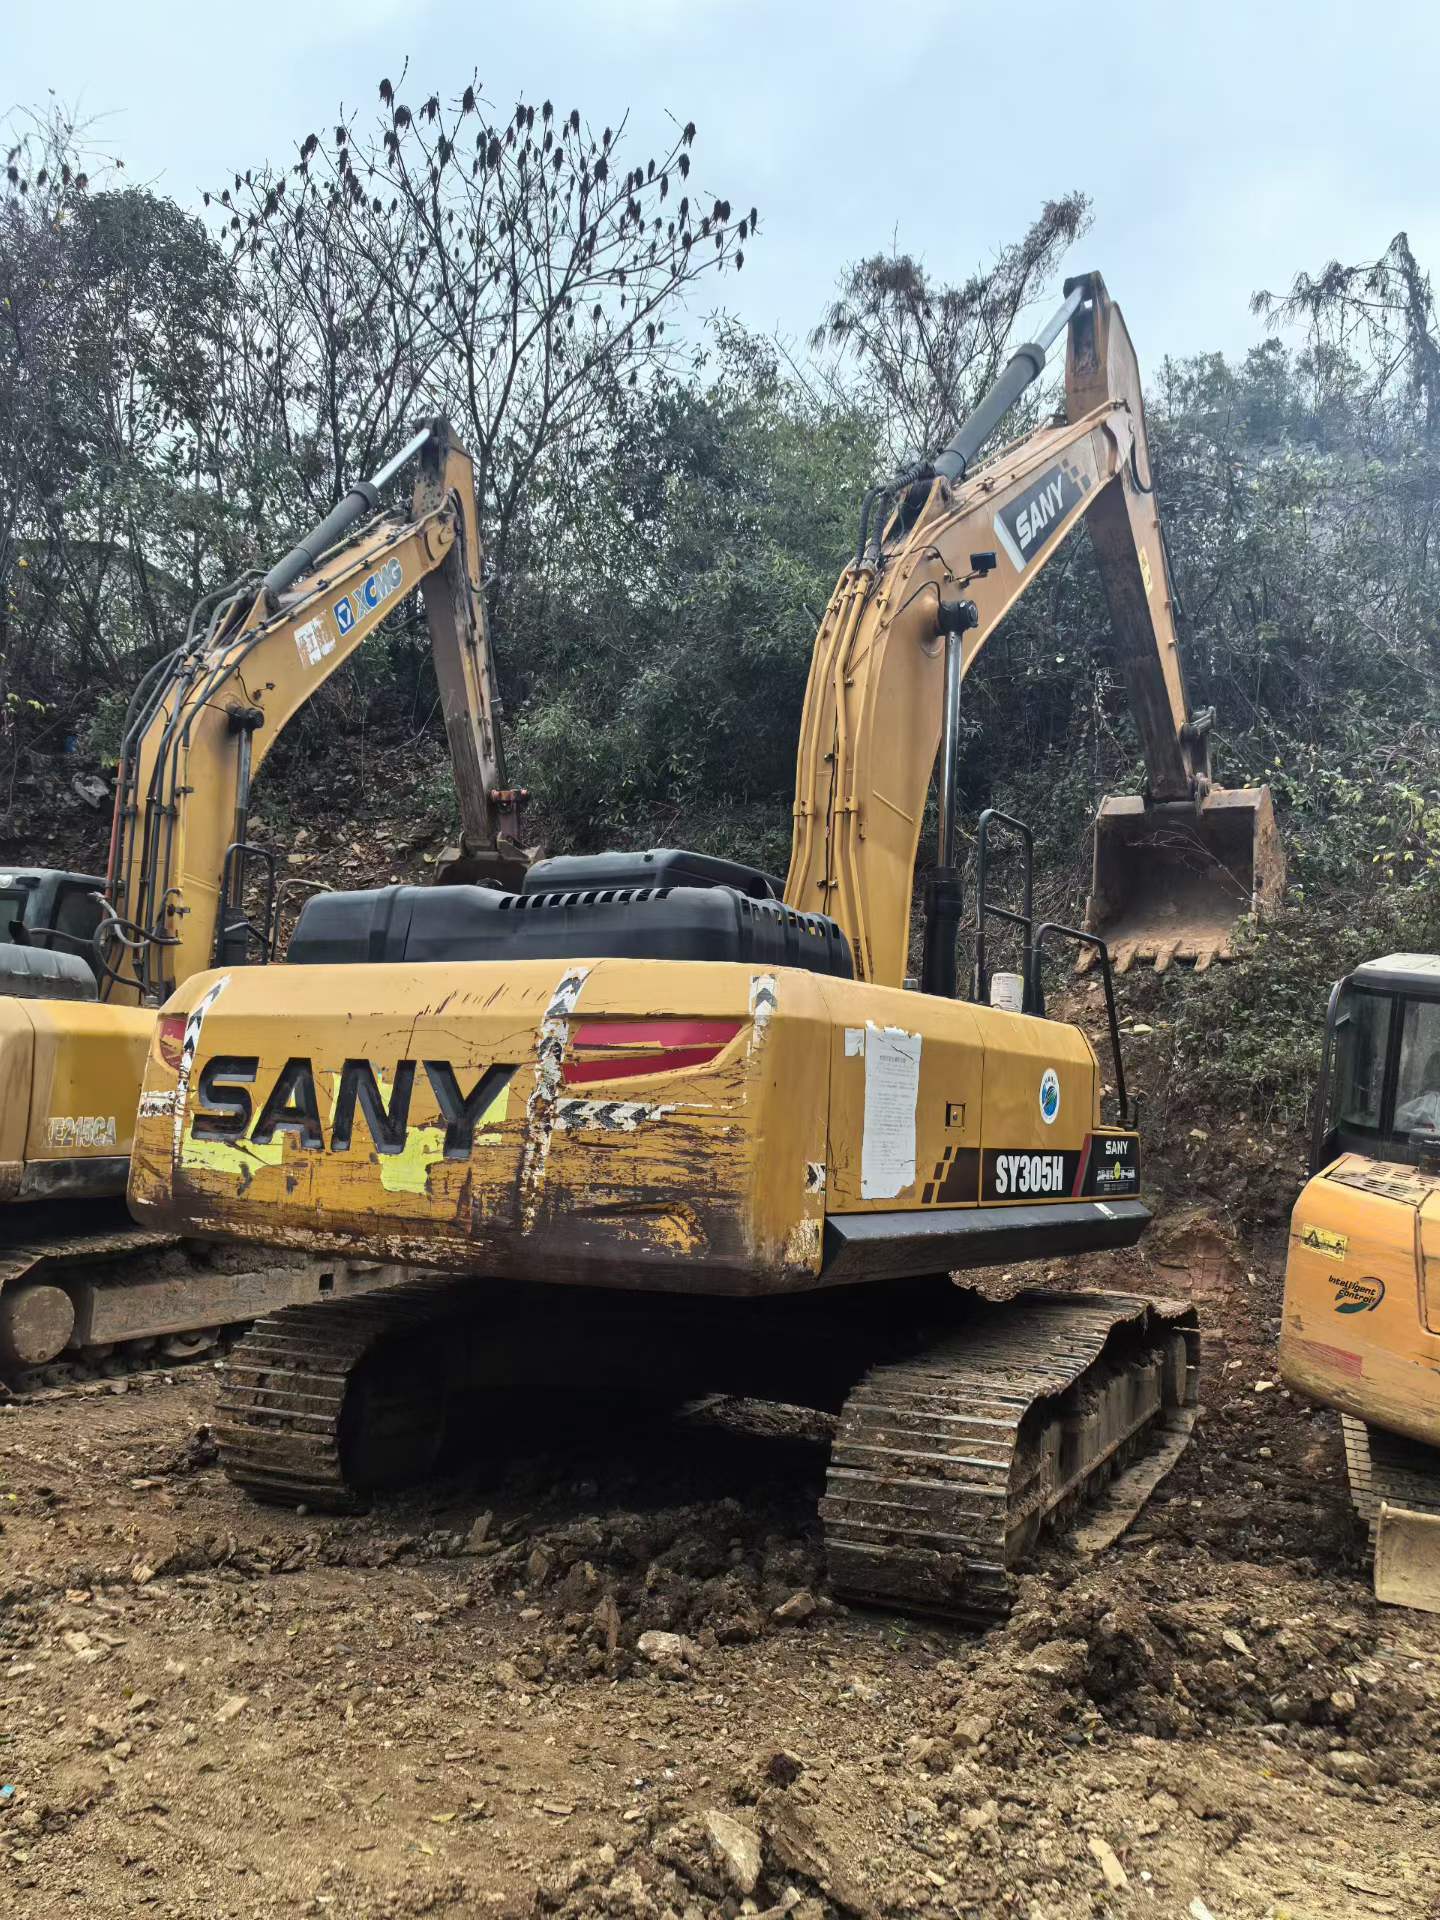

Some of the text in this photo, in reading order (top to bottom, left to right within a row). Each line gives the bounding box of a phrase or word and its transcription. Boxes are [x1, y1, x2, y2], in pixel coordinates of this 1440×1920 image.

[1016, 473, 1063, 550] SANY
[351, 557, 403, 621] XCMG
[190, 1055, 521, 1162] SANY
[995, 1155, 1064, 1194] SY305H
[1105, 1141, 1129, 1155] SANY
